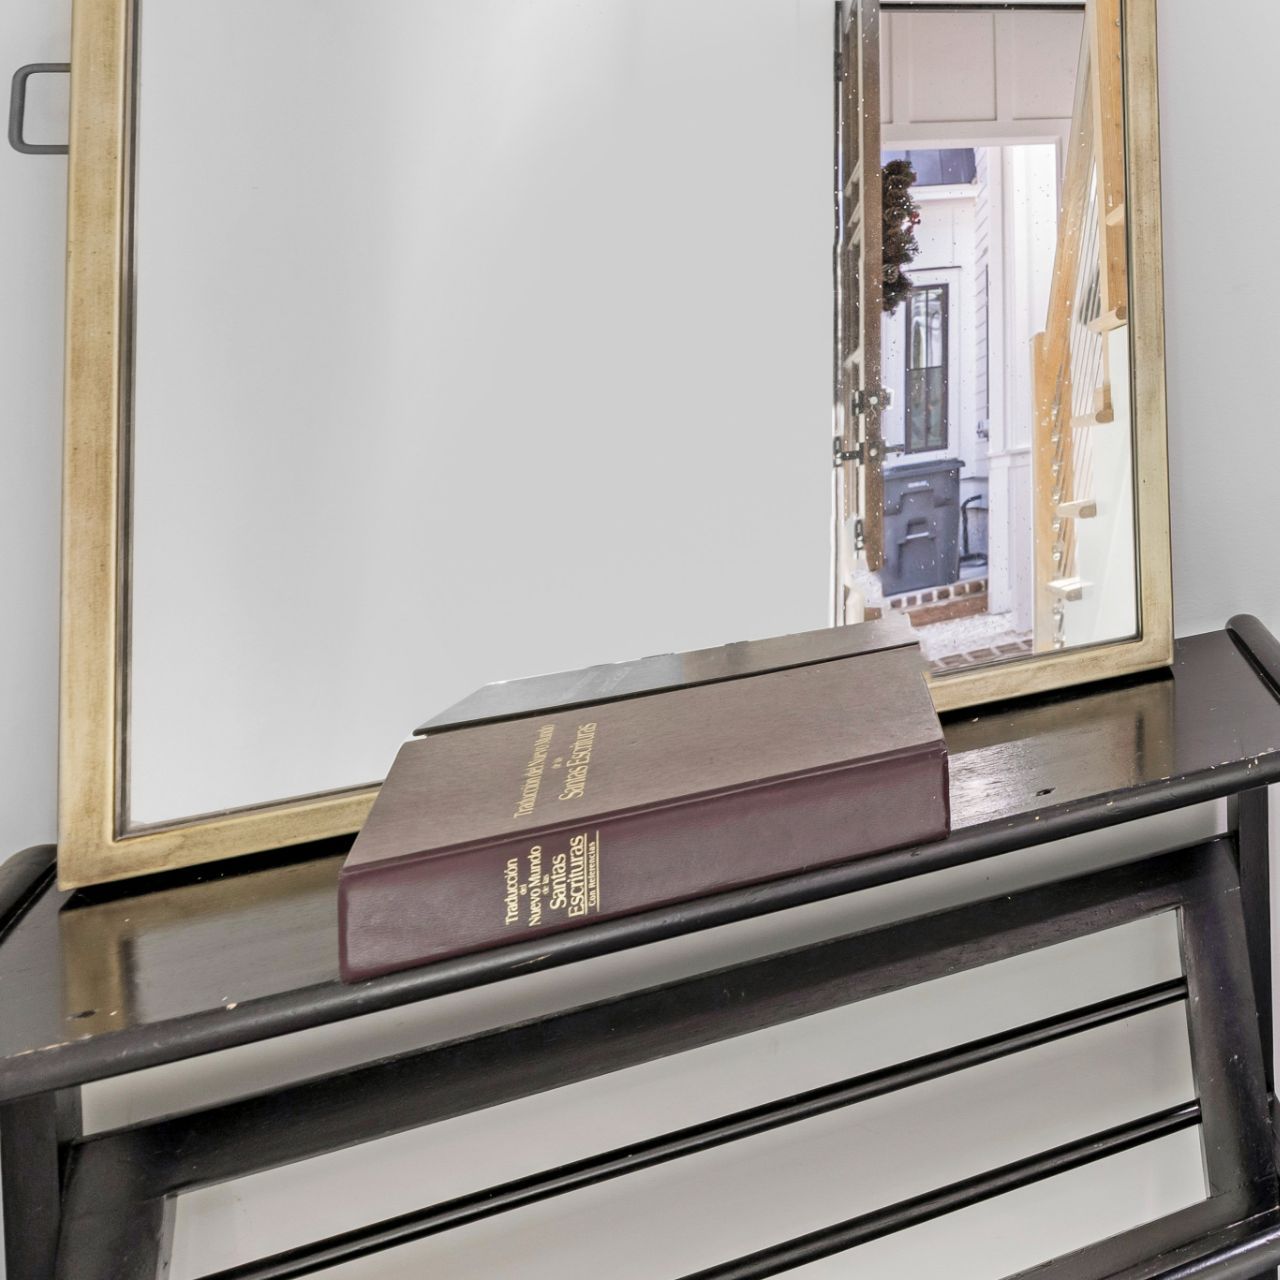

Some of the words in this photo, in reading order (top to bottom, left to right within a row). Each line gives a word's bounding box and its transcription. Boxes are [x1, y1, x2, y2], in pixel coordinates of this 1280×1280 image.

[566, 723, 597, 767] Escrituras
[559, 765, 588, 800] Santas
[528, 845, 541, 888] Mundo
[550, 853, 566, 910] Santas
[567, 835, 584, 918] Escrituras
[588, 841, 596, 889] Referencias
[504, 858, 519, 926] Traducción
[528, 887, 541, 927] Nuevo
[588, 889, 596, 907] Con
